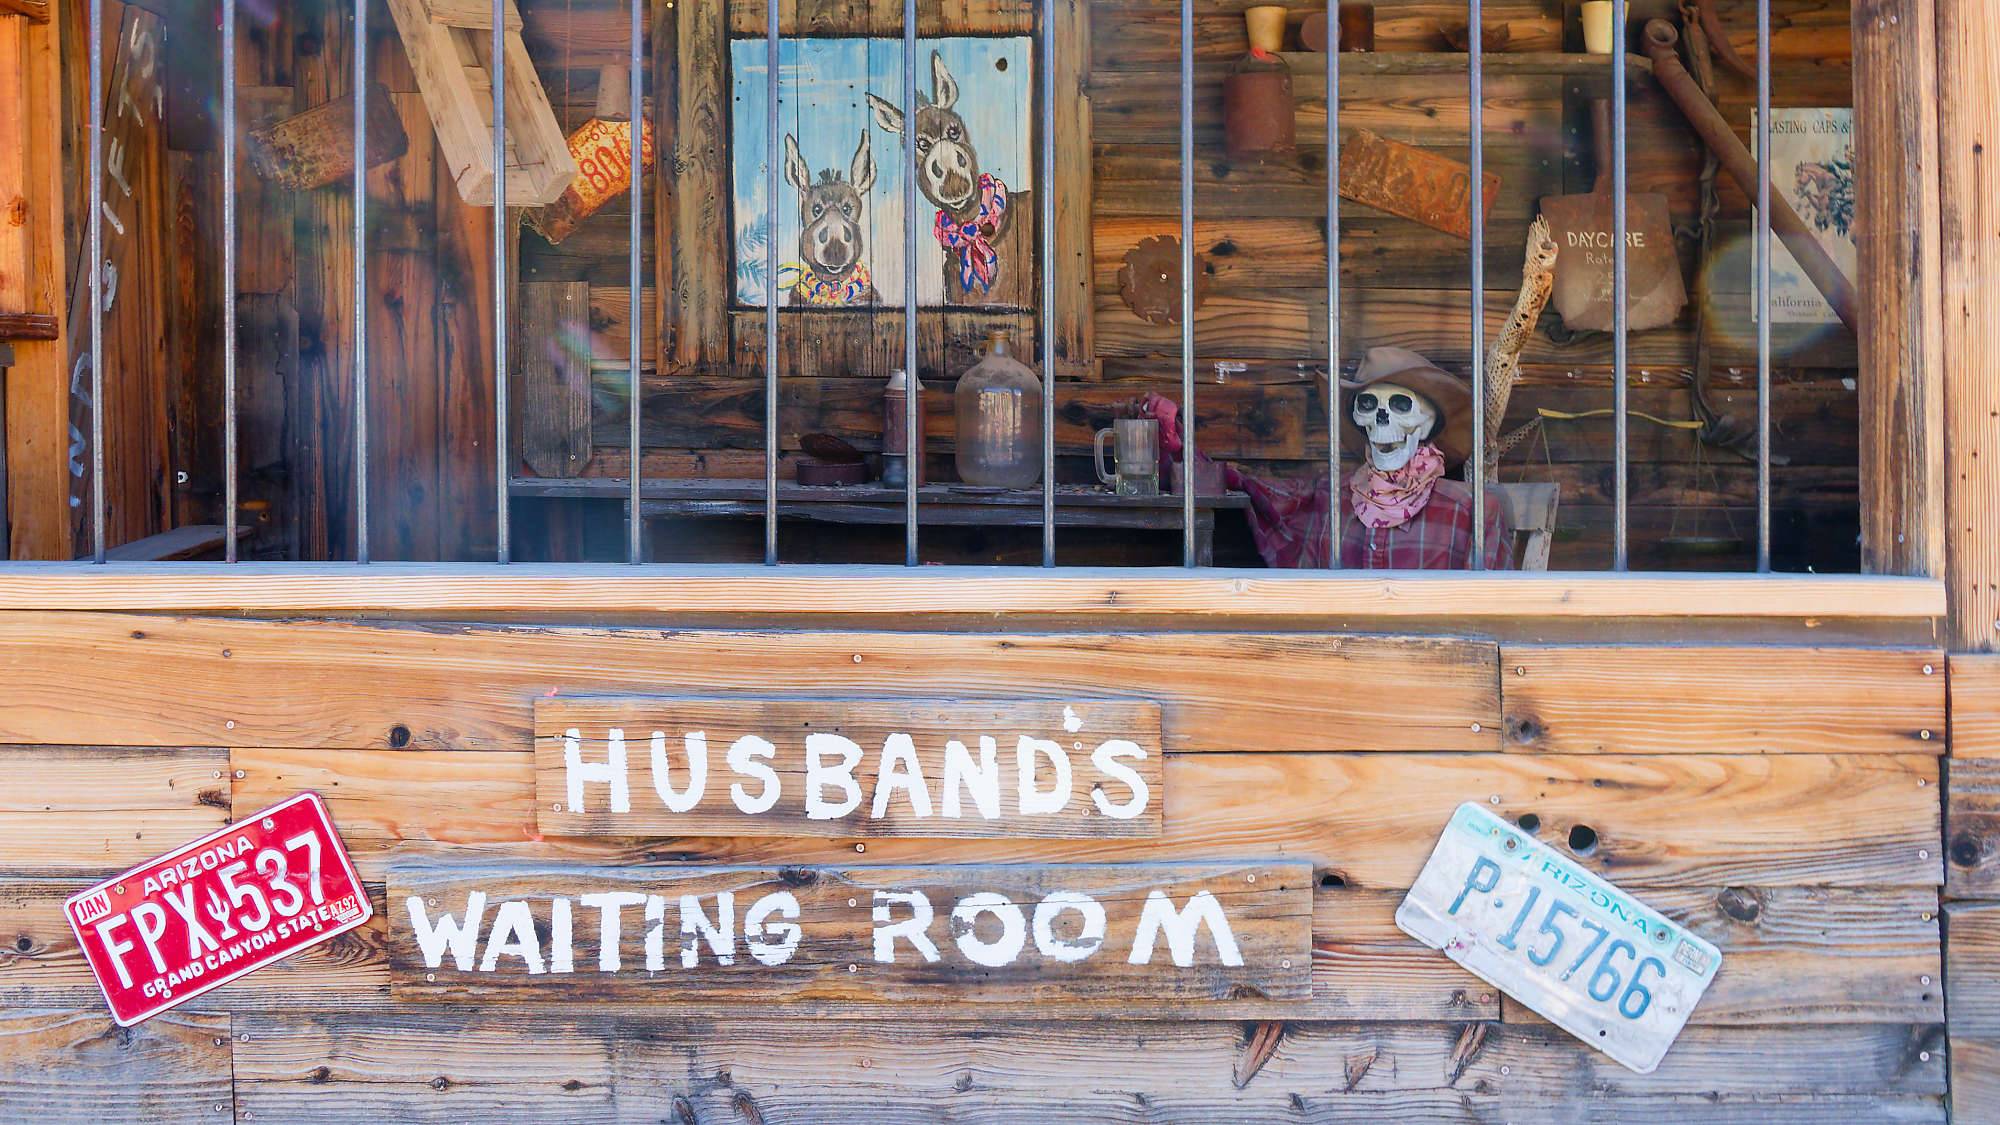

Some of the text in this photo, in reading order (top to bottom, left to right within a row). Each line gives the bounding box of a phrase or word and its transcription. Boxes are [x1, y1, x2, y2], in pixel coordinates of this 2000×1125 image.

[1769, 120, 1807, 134] ASTING
[1813, 120, 1837, 134] CAPS
[1770, 295, 1823, 308] alifornia
[563, 705, 1151, 821] HUSBAND'S
[143, 836, 255, 897] ARIZONA
[78, 893, 107, 922] JAN
[96, 830, 325, 990] FPX 537
[405, 888, 1247, 976] WAITING ROOM
[143, 961, 205, 998] GRAND
[205, 928, 277, 970] CANYON
[277, 905, 332, 939] STATE
